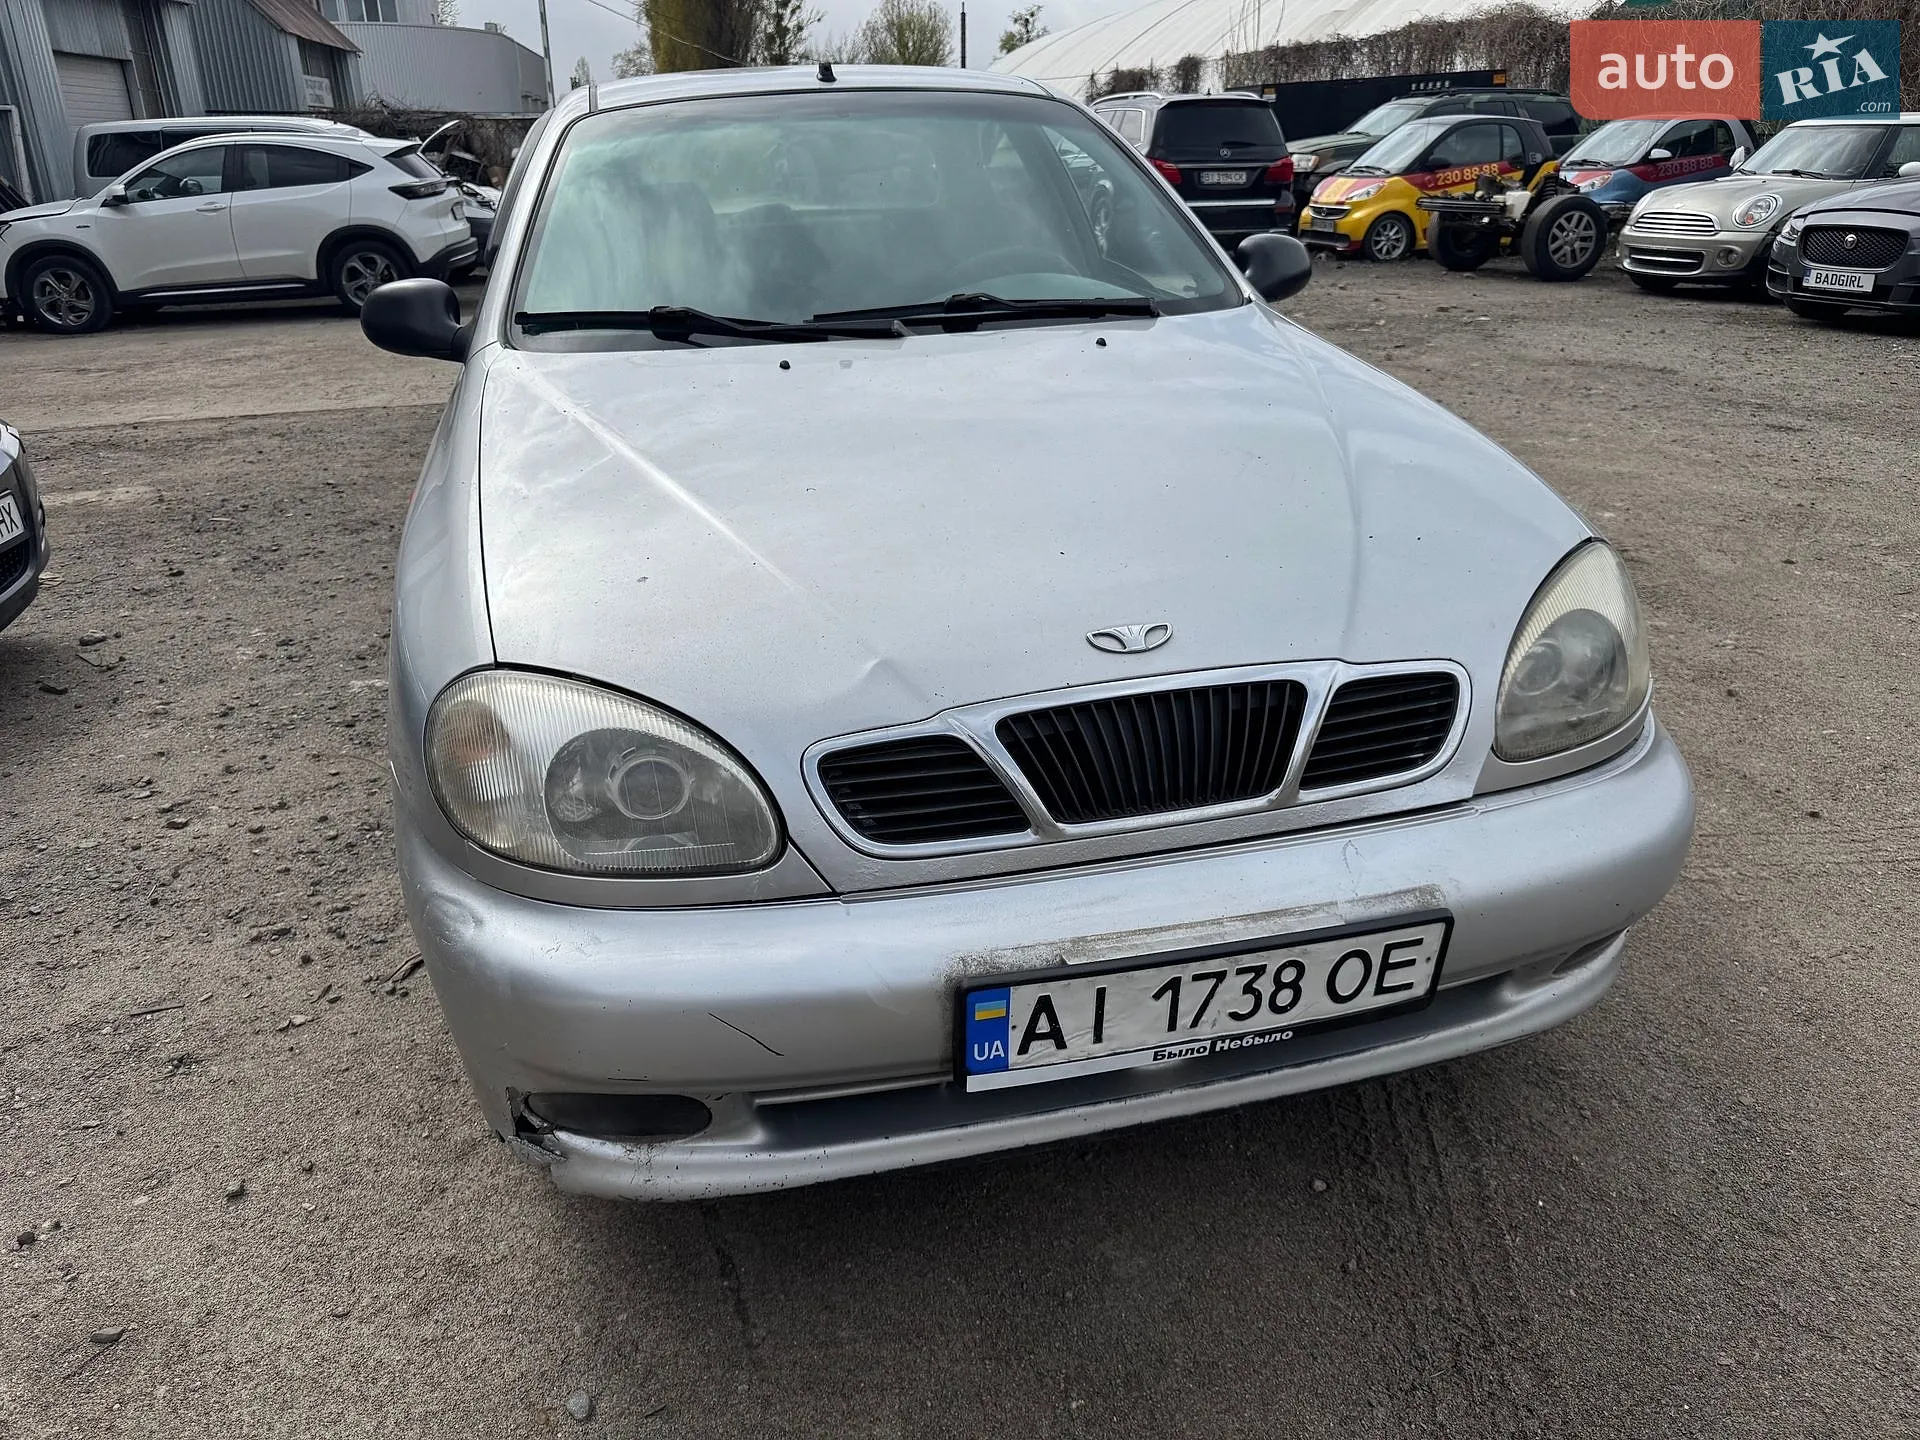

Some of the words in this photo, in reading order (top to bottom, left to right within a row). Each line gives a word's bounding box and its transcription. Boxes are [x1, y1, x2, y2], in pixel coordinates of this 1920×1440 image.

[1436, 170, 1461, 186] 230
[1463, 167, 1481, 181] 88
[1658, 162, 1680, 177] 230
[1682, 159, 1698, 173] 88
[1815, 272, 1864, 289] BADGIRL
[1016, 986, 1107, 1056] AI
[1151, 959, 1306, 1033] 1738
[1326, 937, 1425, 1005] OE
[974, 1040, 1005, 1061] UA
[1152, 1045, 1208, 1062] Было
[1215, 1030, 1294, 1052] Небыло
